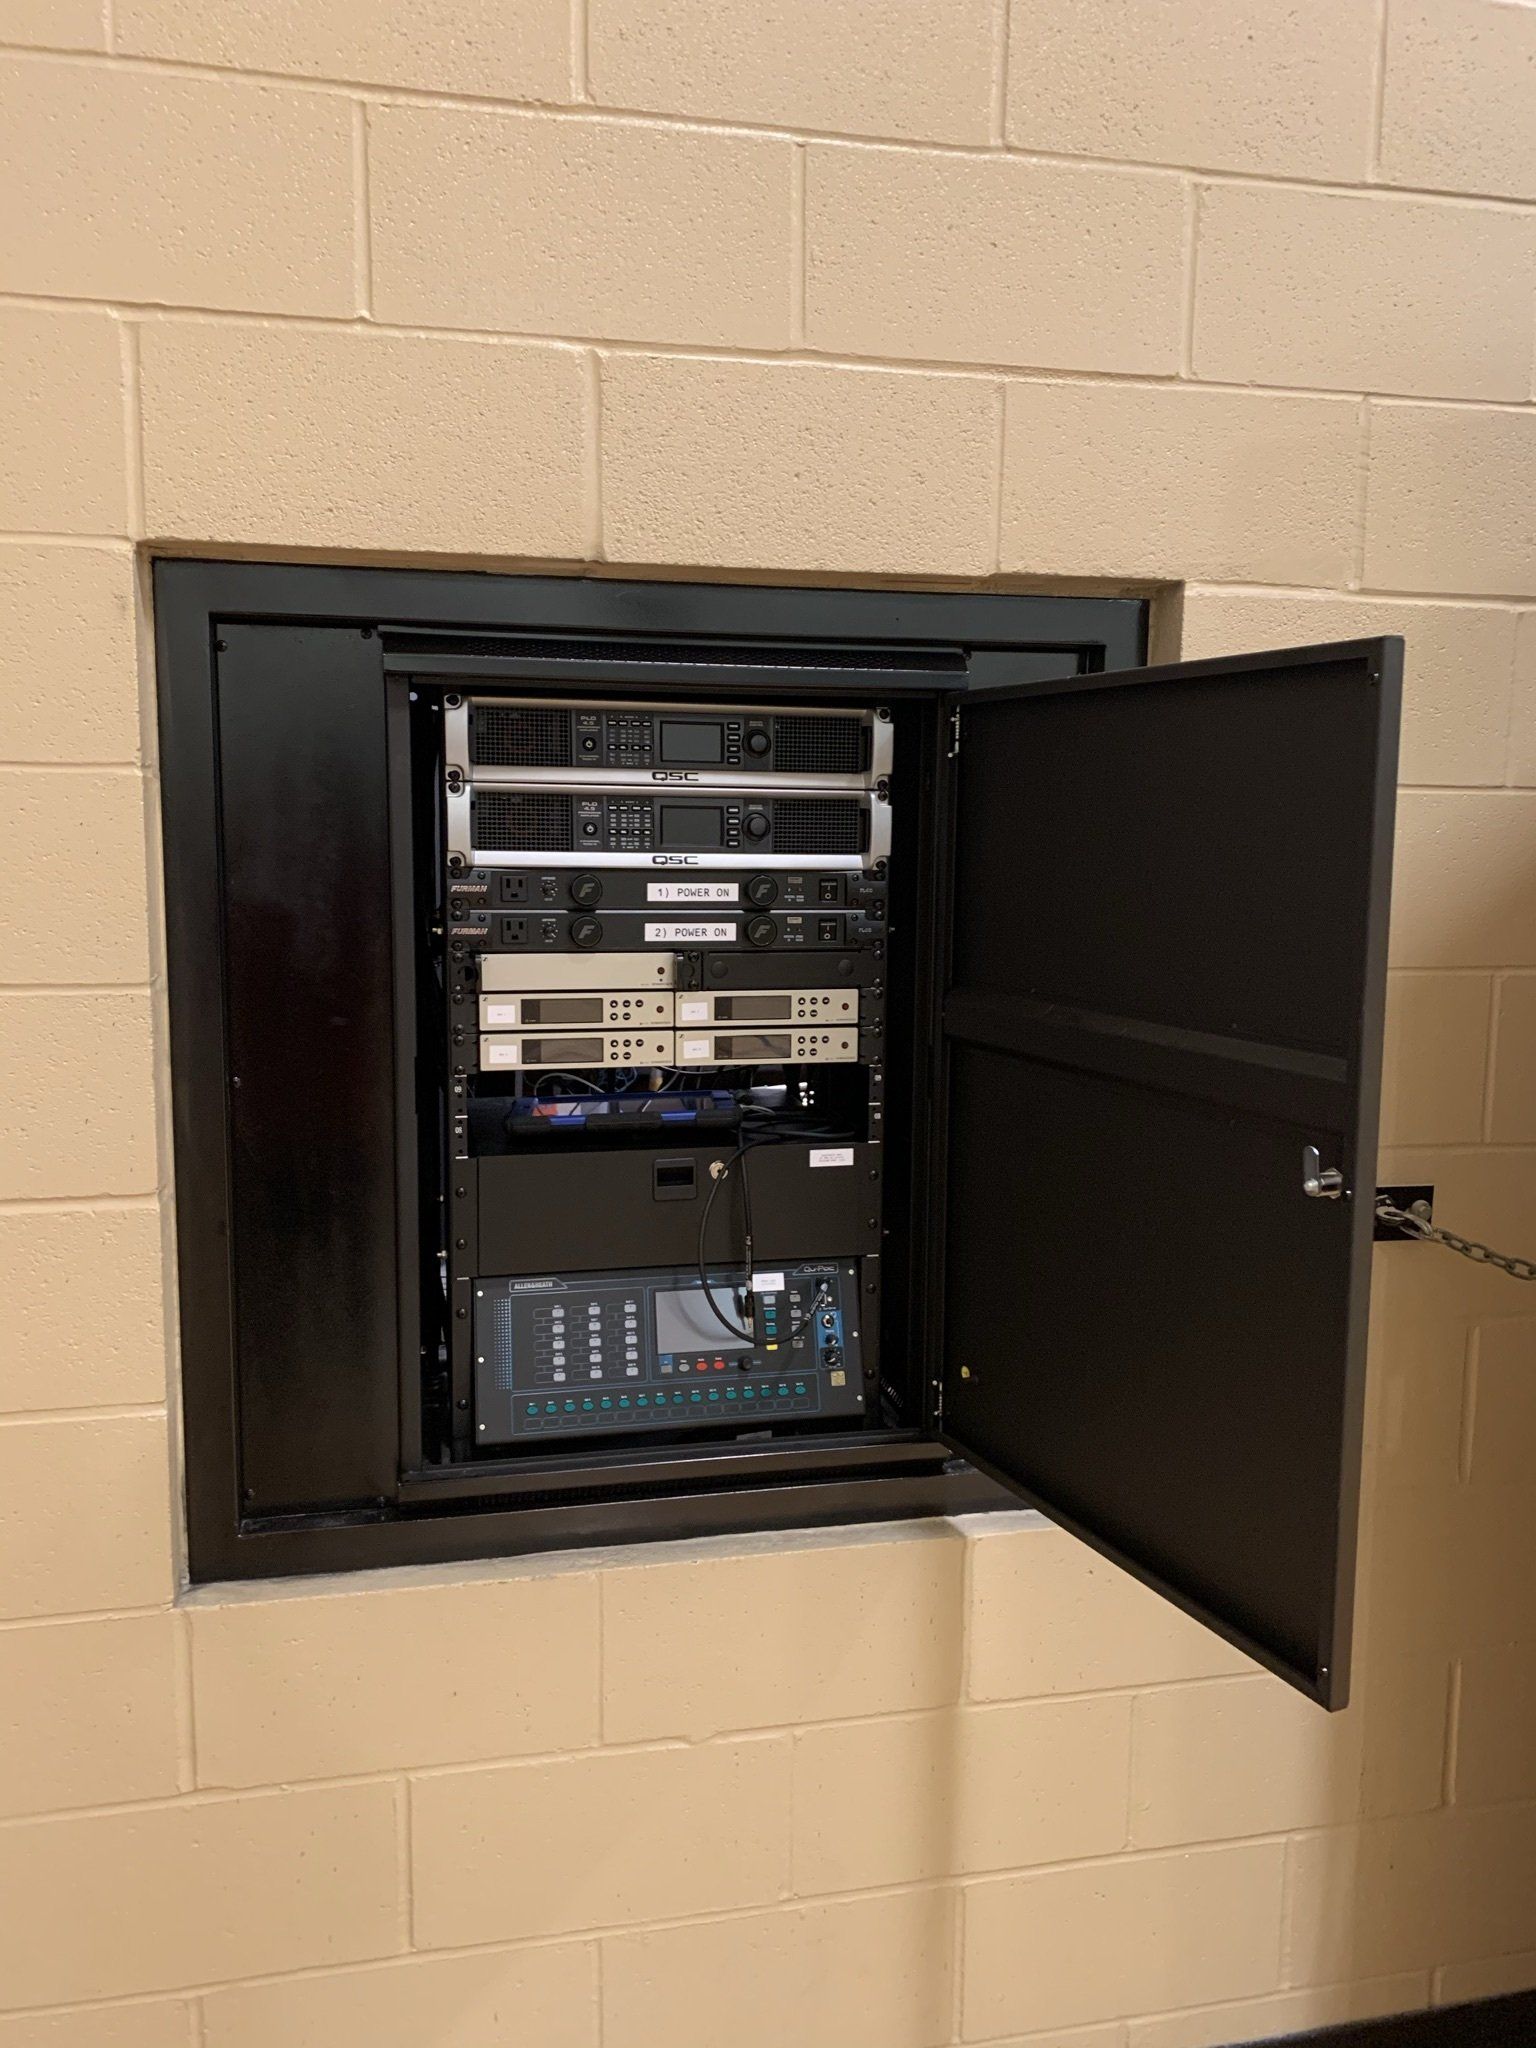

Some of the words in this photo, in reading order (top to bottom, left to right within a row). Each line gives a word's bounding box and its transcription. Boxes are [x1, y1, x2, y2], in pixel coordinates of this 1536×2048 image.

[652, 771, 699, 781] QSC
[652, 855, 699, 865] QSC
[450, 885, 488, 893] FURMAN
[658, 888, 669, 898] 1)
[677, 888, 710, 897] POWER
[716, 888, 730, 897] ON
[451, 927, 488, 935] FURMAN
[655, 928, 667, 938] 2)
[675, 928, 708, 937] POWER
[714, 928, 727, 937] ON
